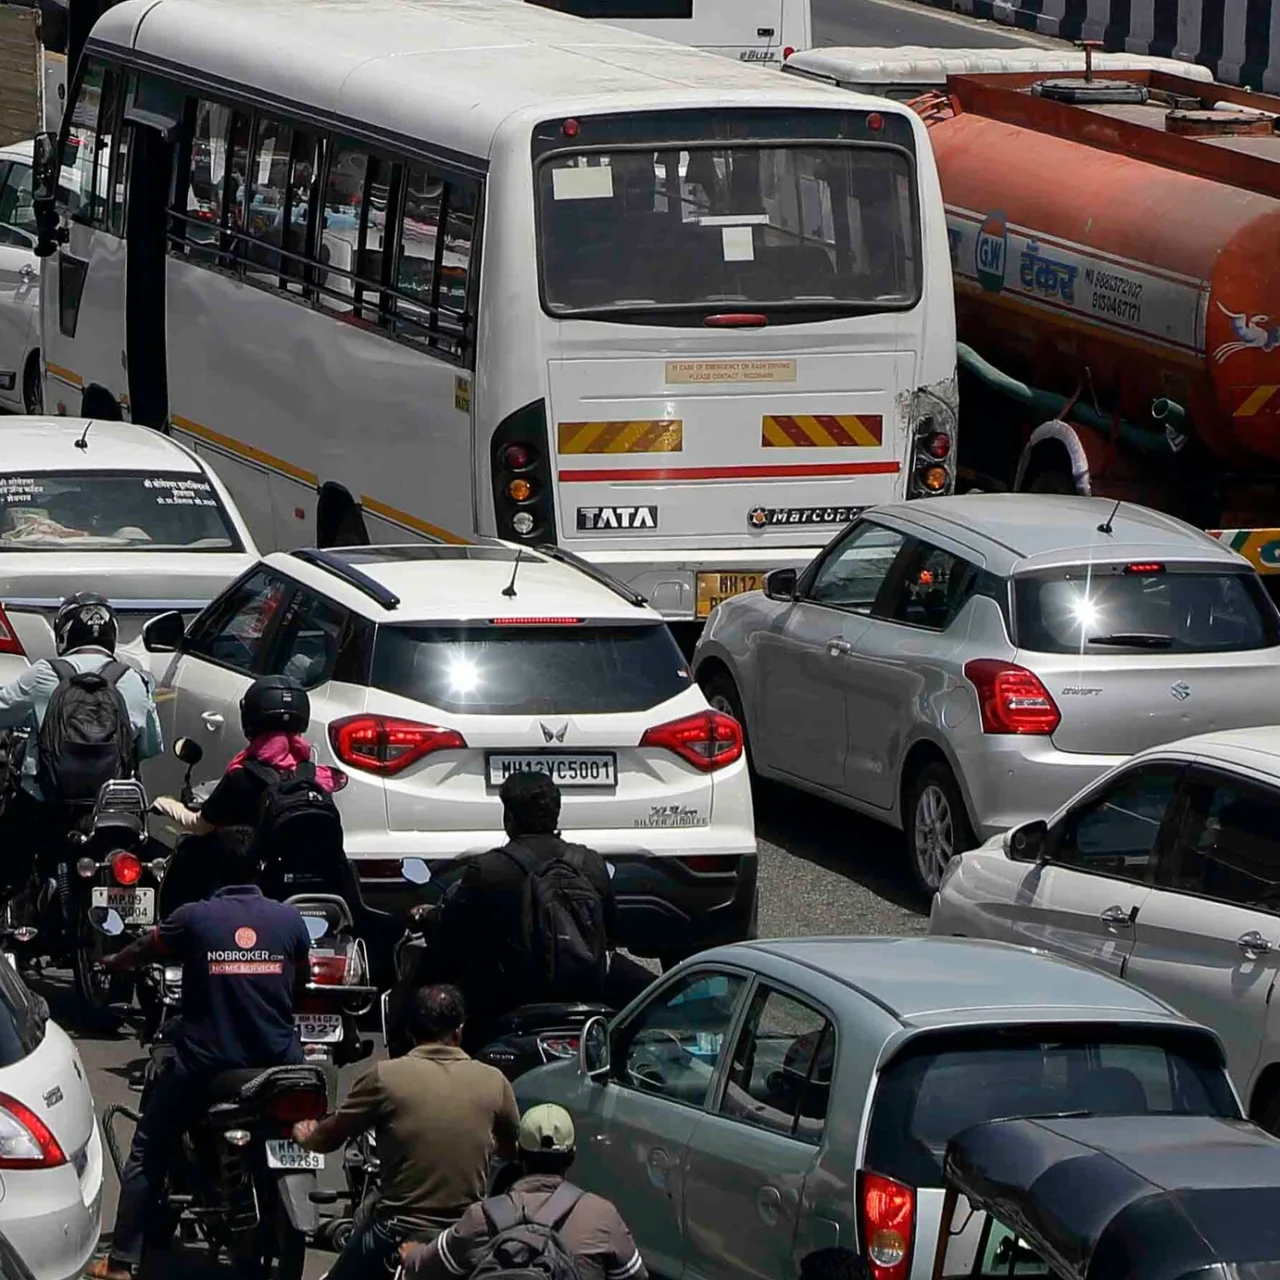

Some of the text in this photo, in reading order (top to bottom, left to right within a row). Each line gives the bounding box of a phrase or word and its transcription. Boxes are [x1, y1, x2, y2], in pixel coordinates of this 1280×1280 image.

[581, 507, 655, 528] TATA
[772, 505, 863, 524] Marcopo
[720, 575, 757, 594] MH 12
[212, 963, 281, 973] HOME SERVICES
[295, 1023, 339, 1033] 1927
